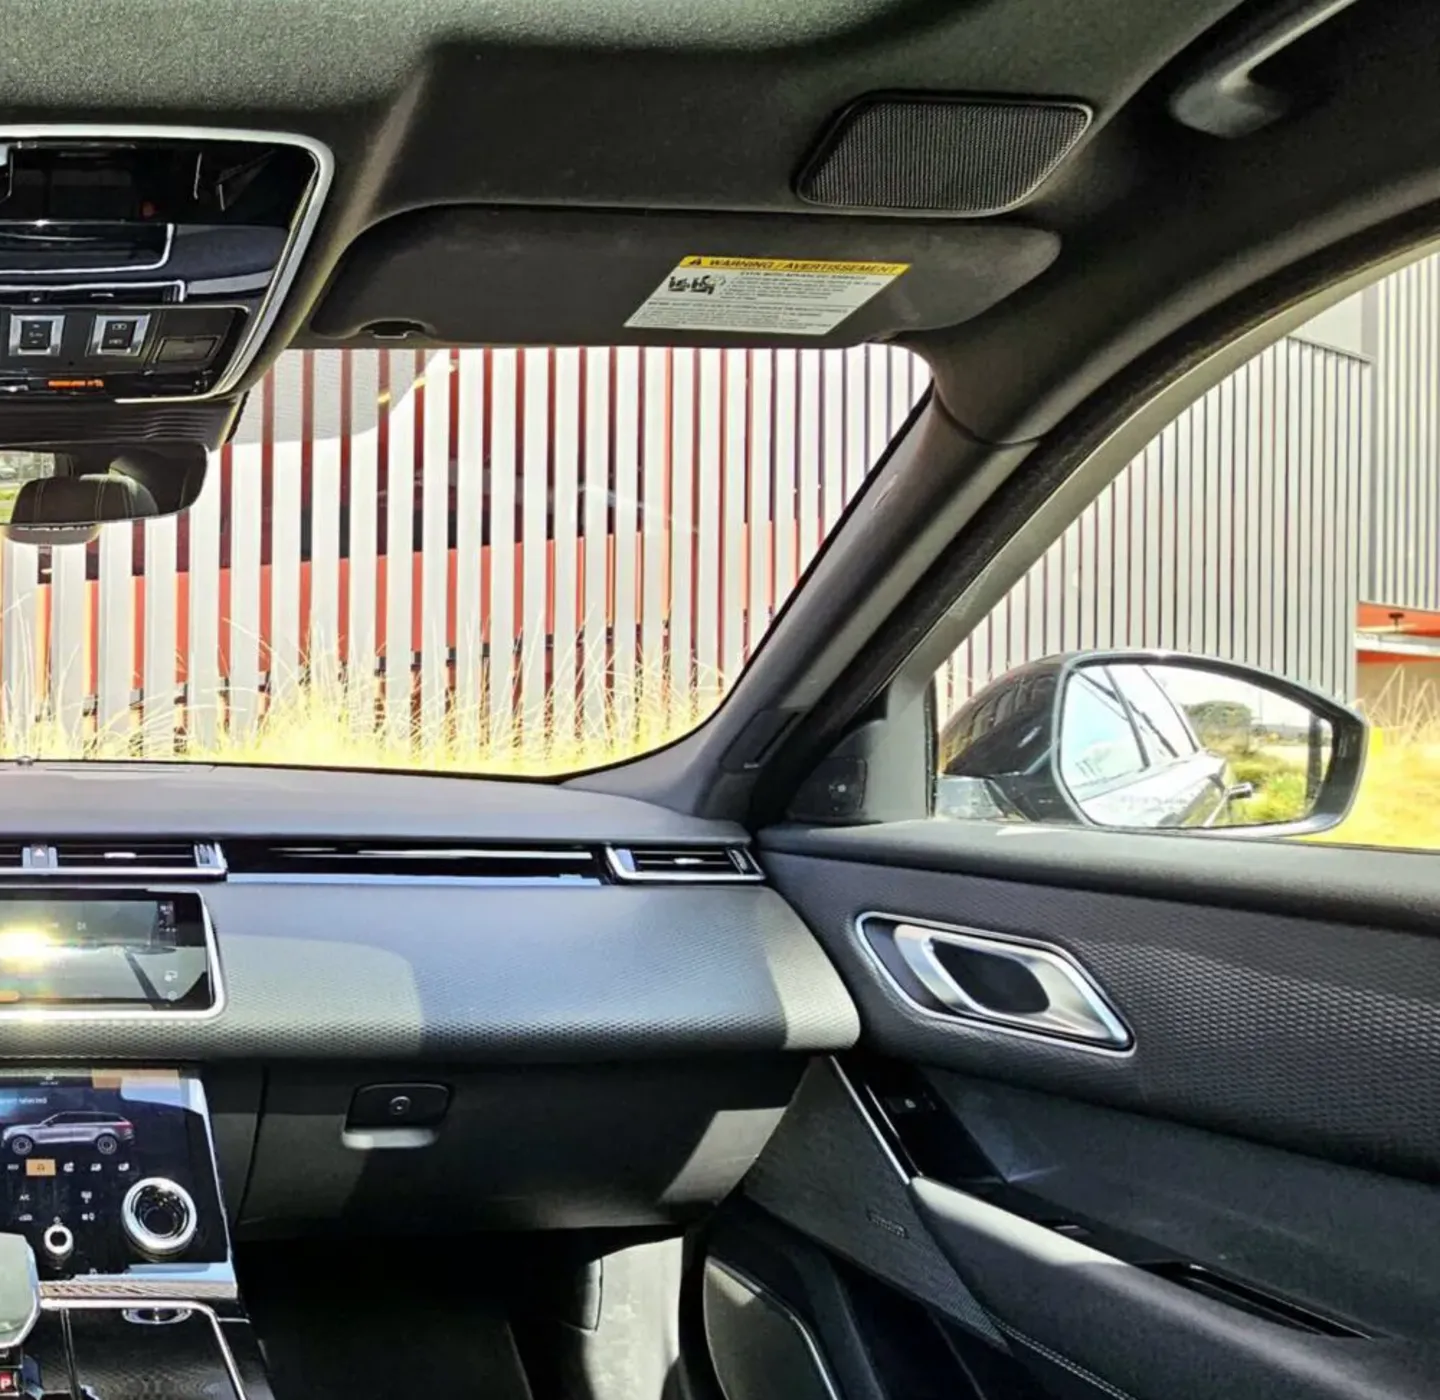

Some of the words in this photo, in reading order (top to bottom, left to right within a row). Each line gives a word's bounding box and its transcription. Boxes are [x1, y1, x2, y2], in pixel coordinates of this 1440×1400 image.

[708, 260, 772, 270] WARNING
[782, 262, 900, 274] AVERTISSEMENT
[0, 1378, 12, 1390] P
